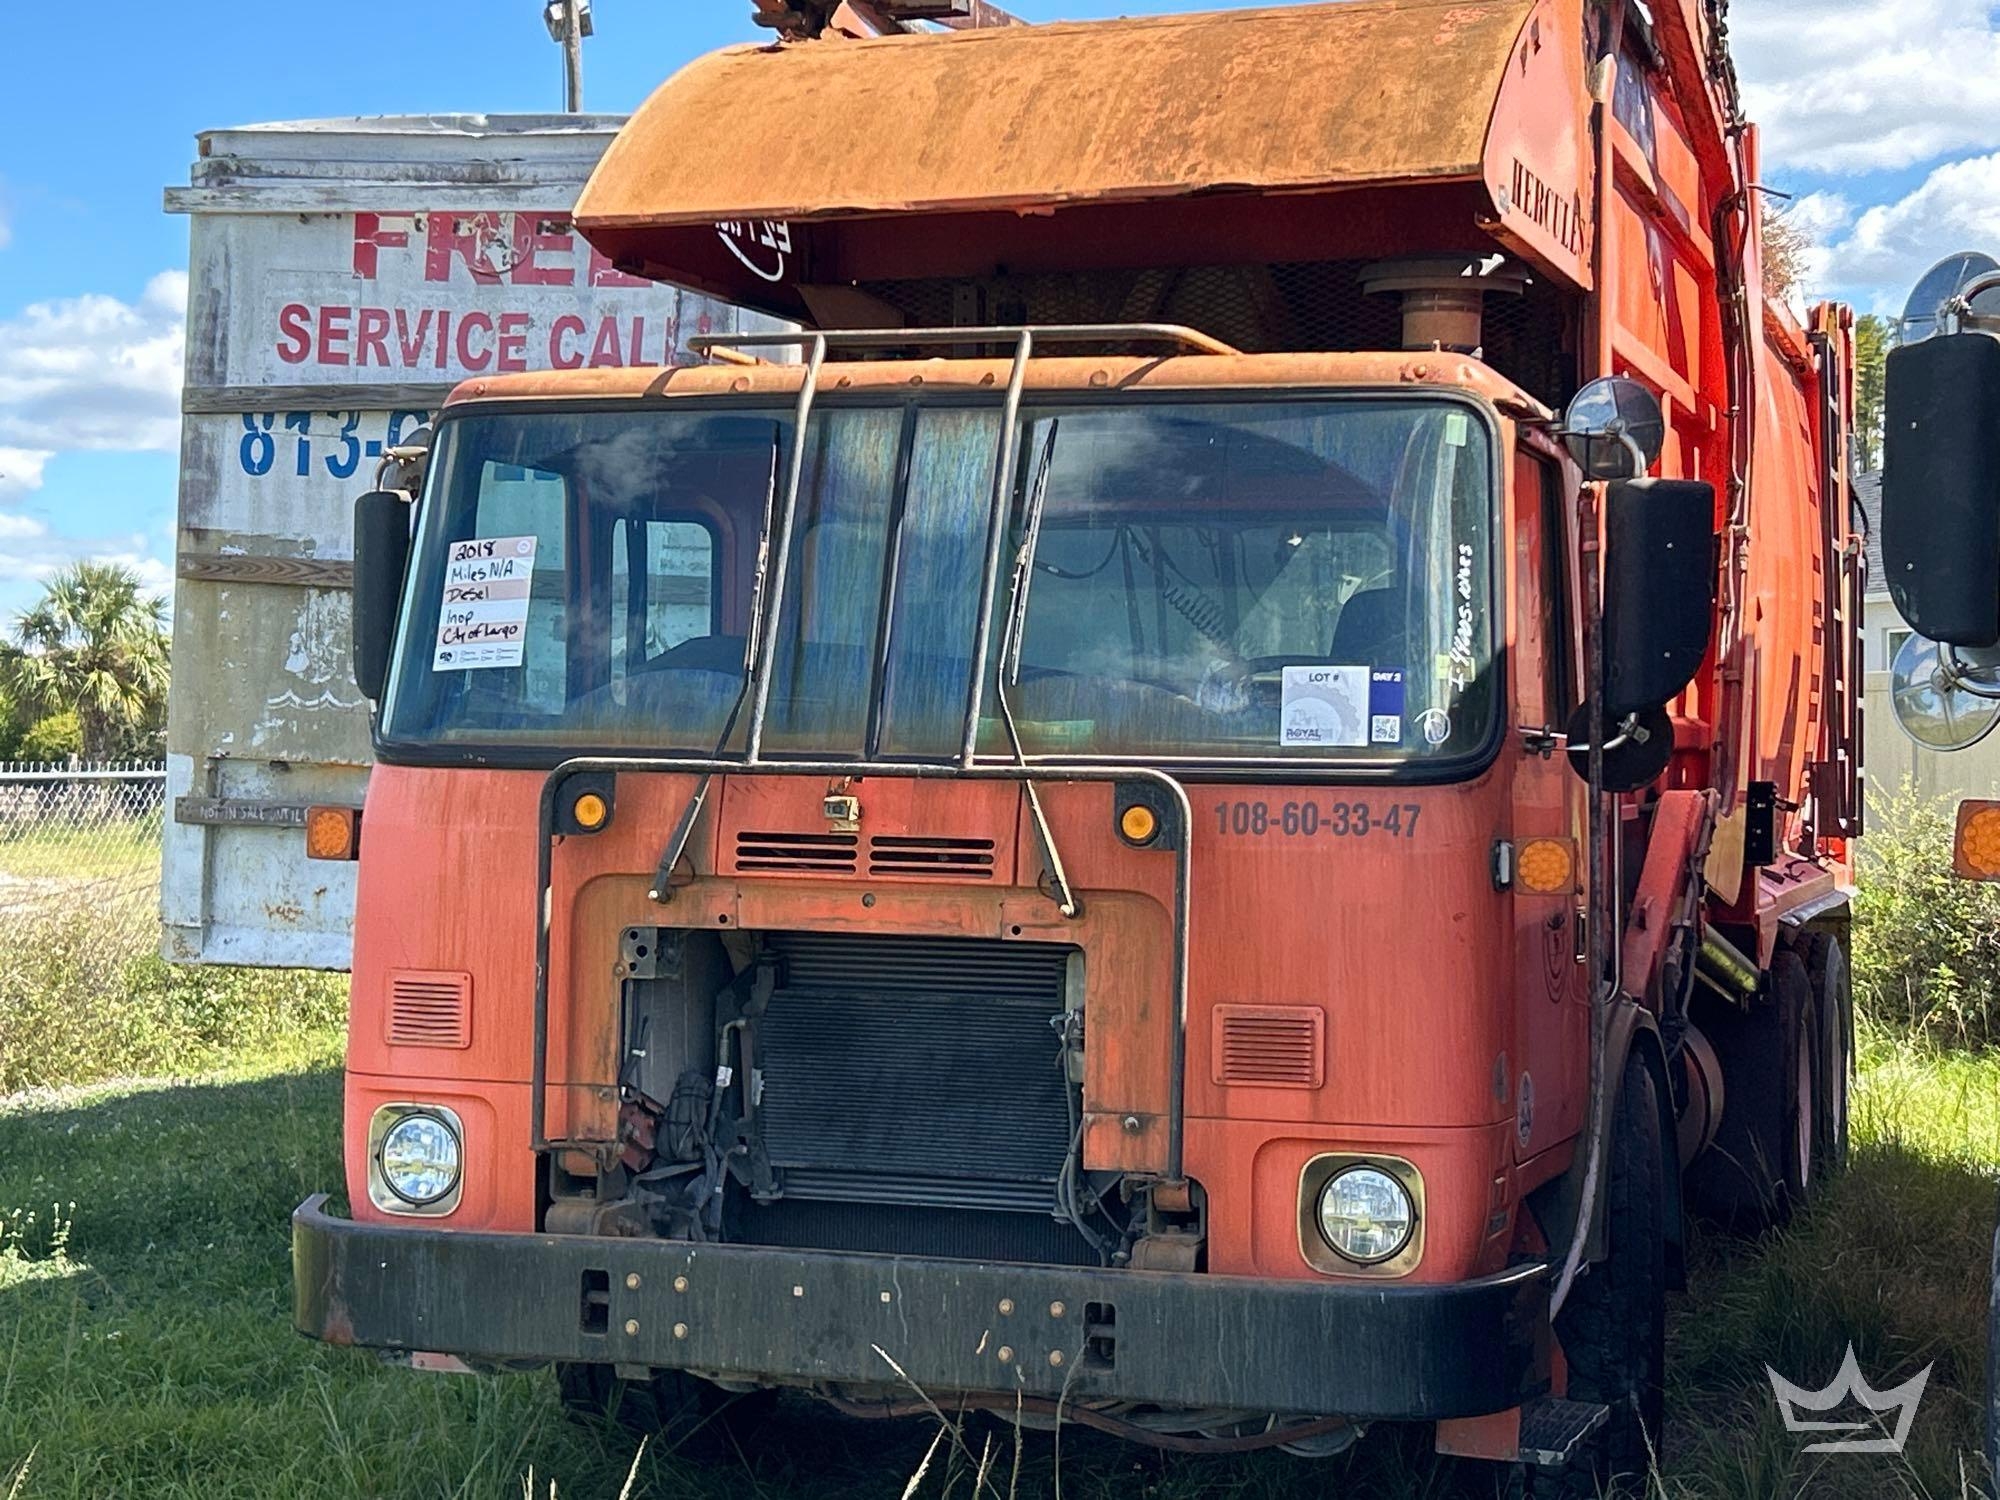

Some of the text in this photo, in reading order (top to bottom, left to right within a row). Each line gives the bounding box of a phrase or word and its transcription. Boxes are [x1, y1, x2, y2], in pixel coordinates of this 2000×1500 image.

[1511, 157, 1585, 257] HERCULES
[276, 303, 528, 371] SERVICE
[455, 541, 496, 560] 2018
[451, 558, 513, 583] Miles N/A
[1309, 673, 1331, 682] LOT
[1373, 672, 1392, 682] DAY
[1286, 728, 1321, 738] ROYAL
[1214, 801, 1421, 837] 108-60-33-47
